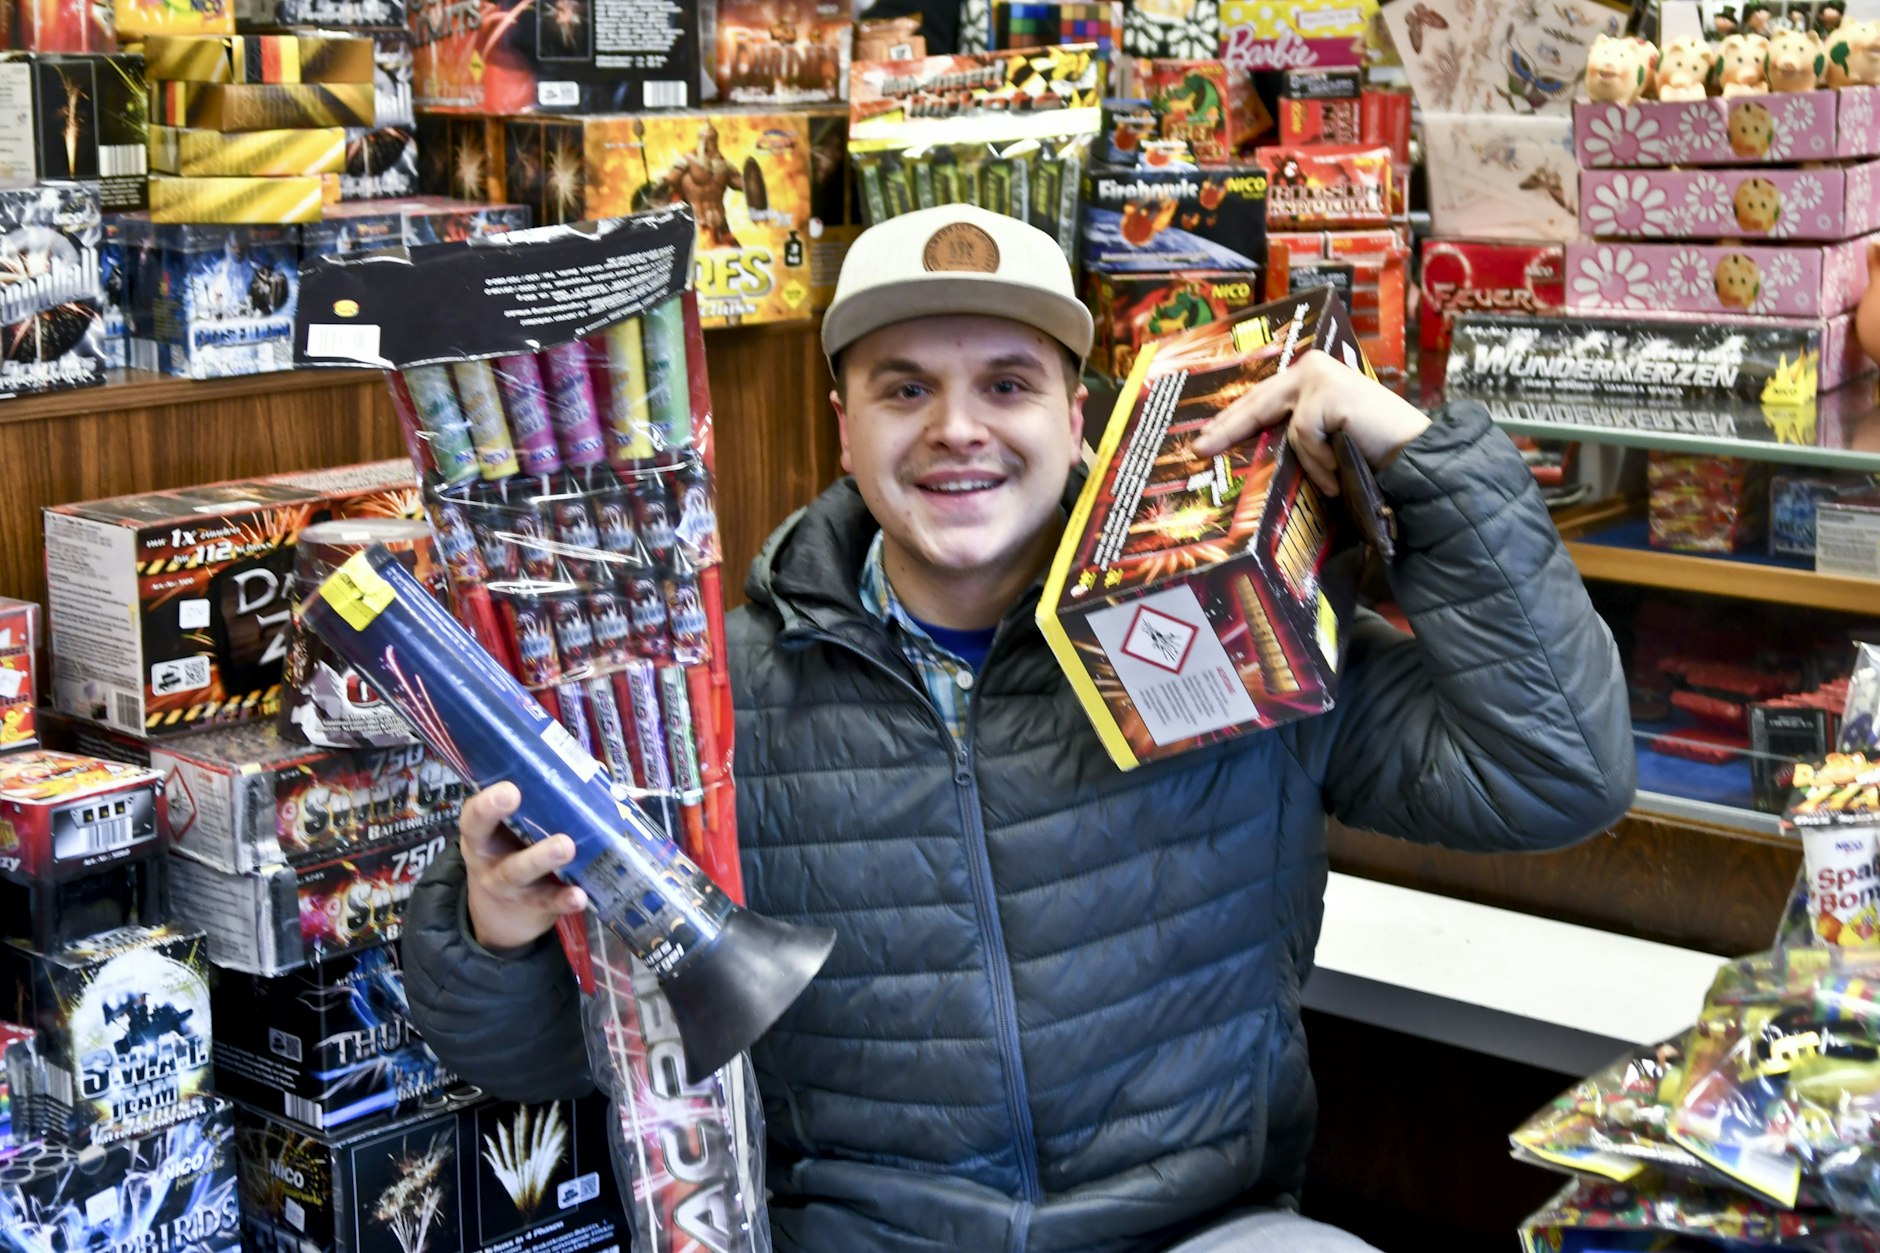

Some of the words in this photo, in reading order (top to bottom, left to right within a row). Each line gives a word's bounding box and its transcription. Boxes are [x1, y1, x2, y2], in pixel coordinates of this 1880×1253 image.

[1226, 24, 1319, 70] Barbie
[1227, 176, 1267, 192] NICO
[1211, 283, 1251, 299] NICO
[171, 527, 199, 548] 1x
[196, 540, 235, 564] 112
[162, 1155, 205, 1183] NICO
[269, 1159, 305, 1189] NICO
